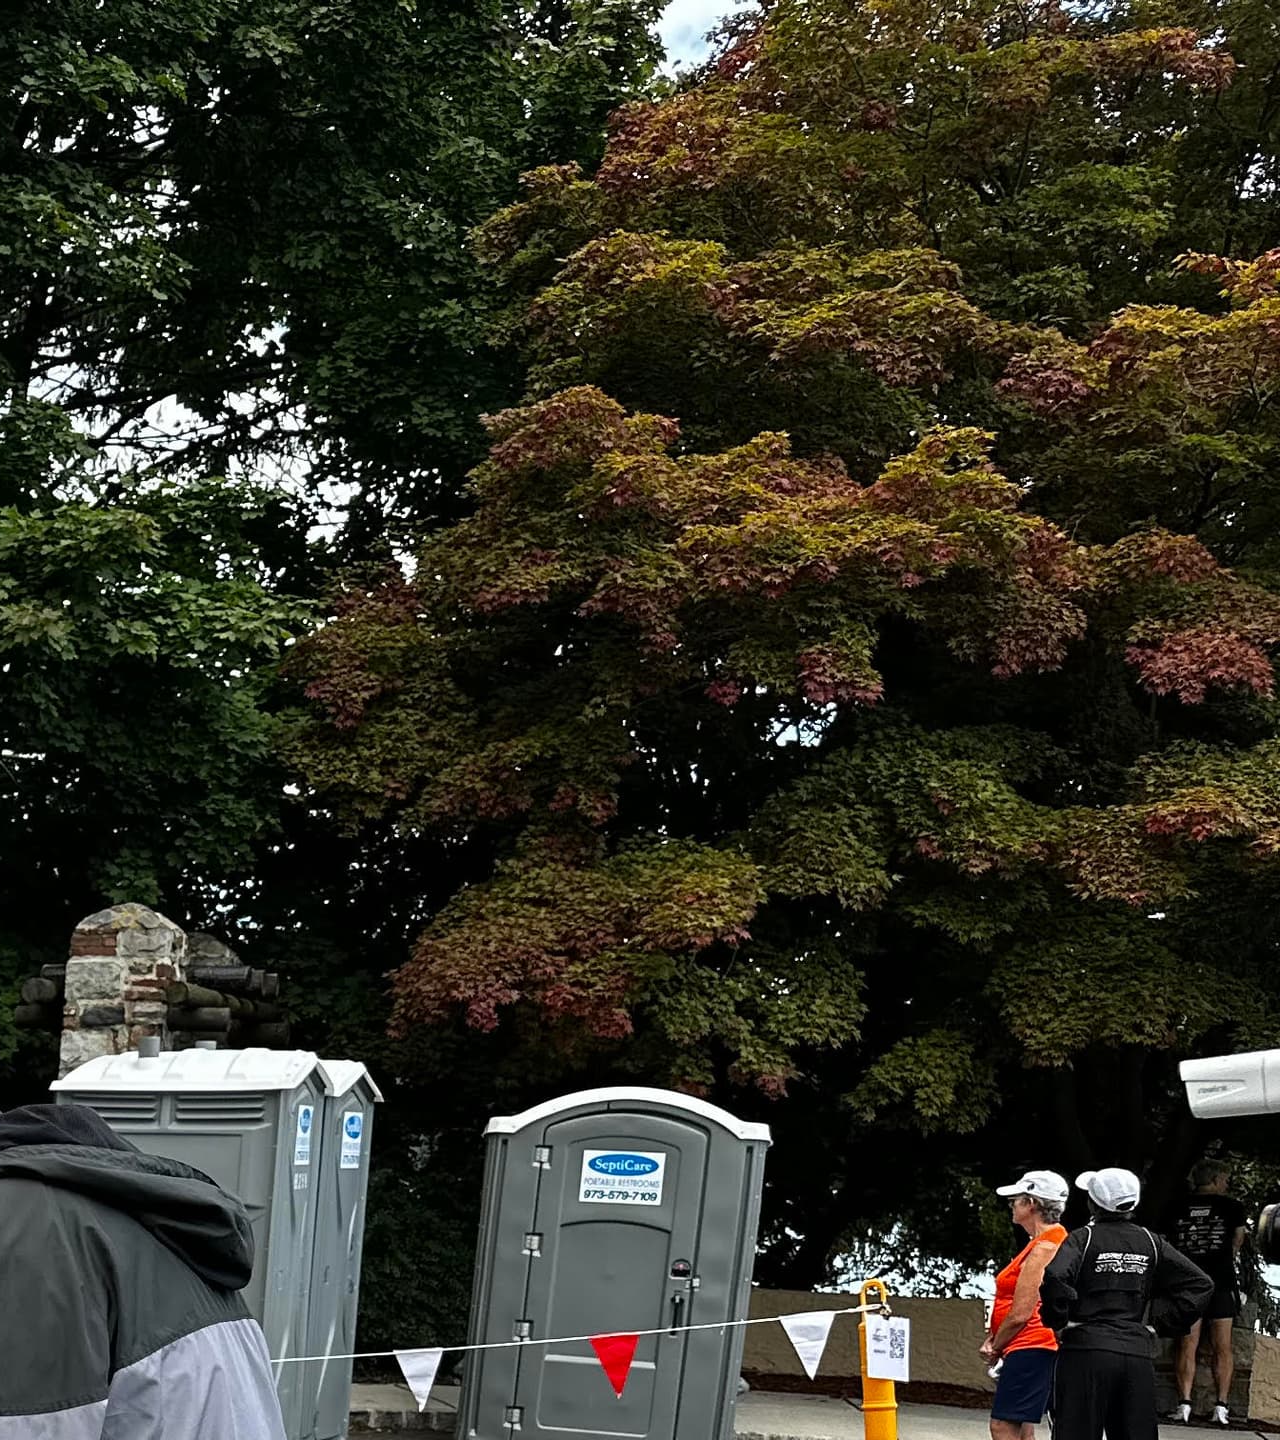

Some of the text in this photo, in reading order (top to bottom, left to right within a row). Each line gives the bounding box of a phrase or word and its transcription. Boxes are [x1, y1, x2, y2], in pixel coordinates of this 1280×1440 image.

[594, 1158, 653, 1173] SeptiCare
[583, 1177, 660, 1188] PORTABLE RESTROOMS
[583, 1189, 658, 1201] 973-579-7109
